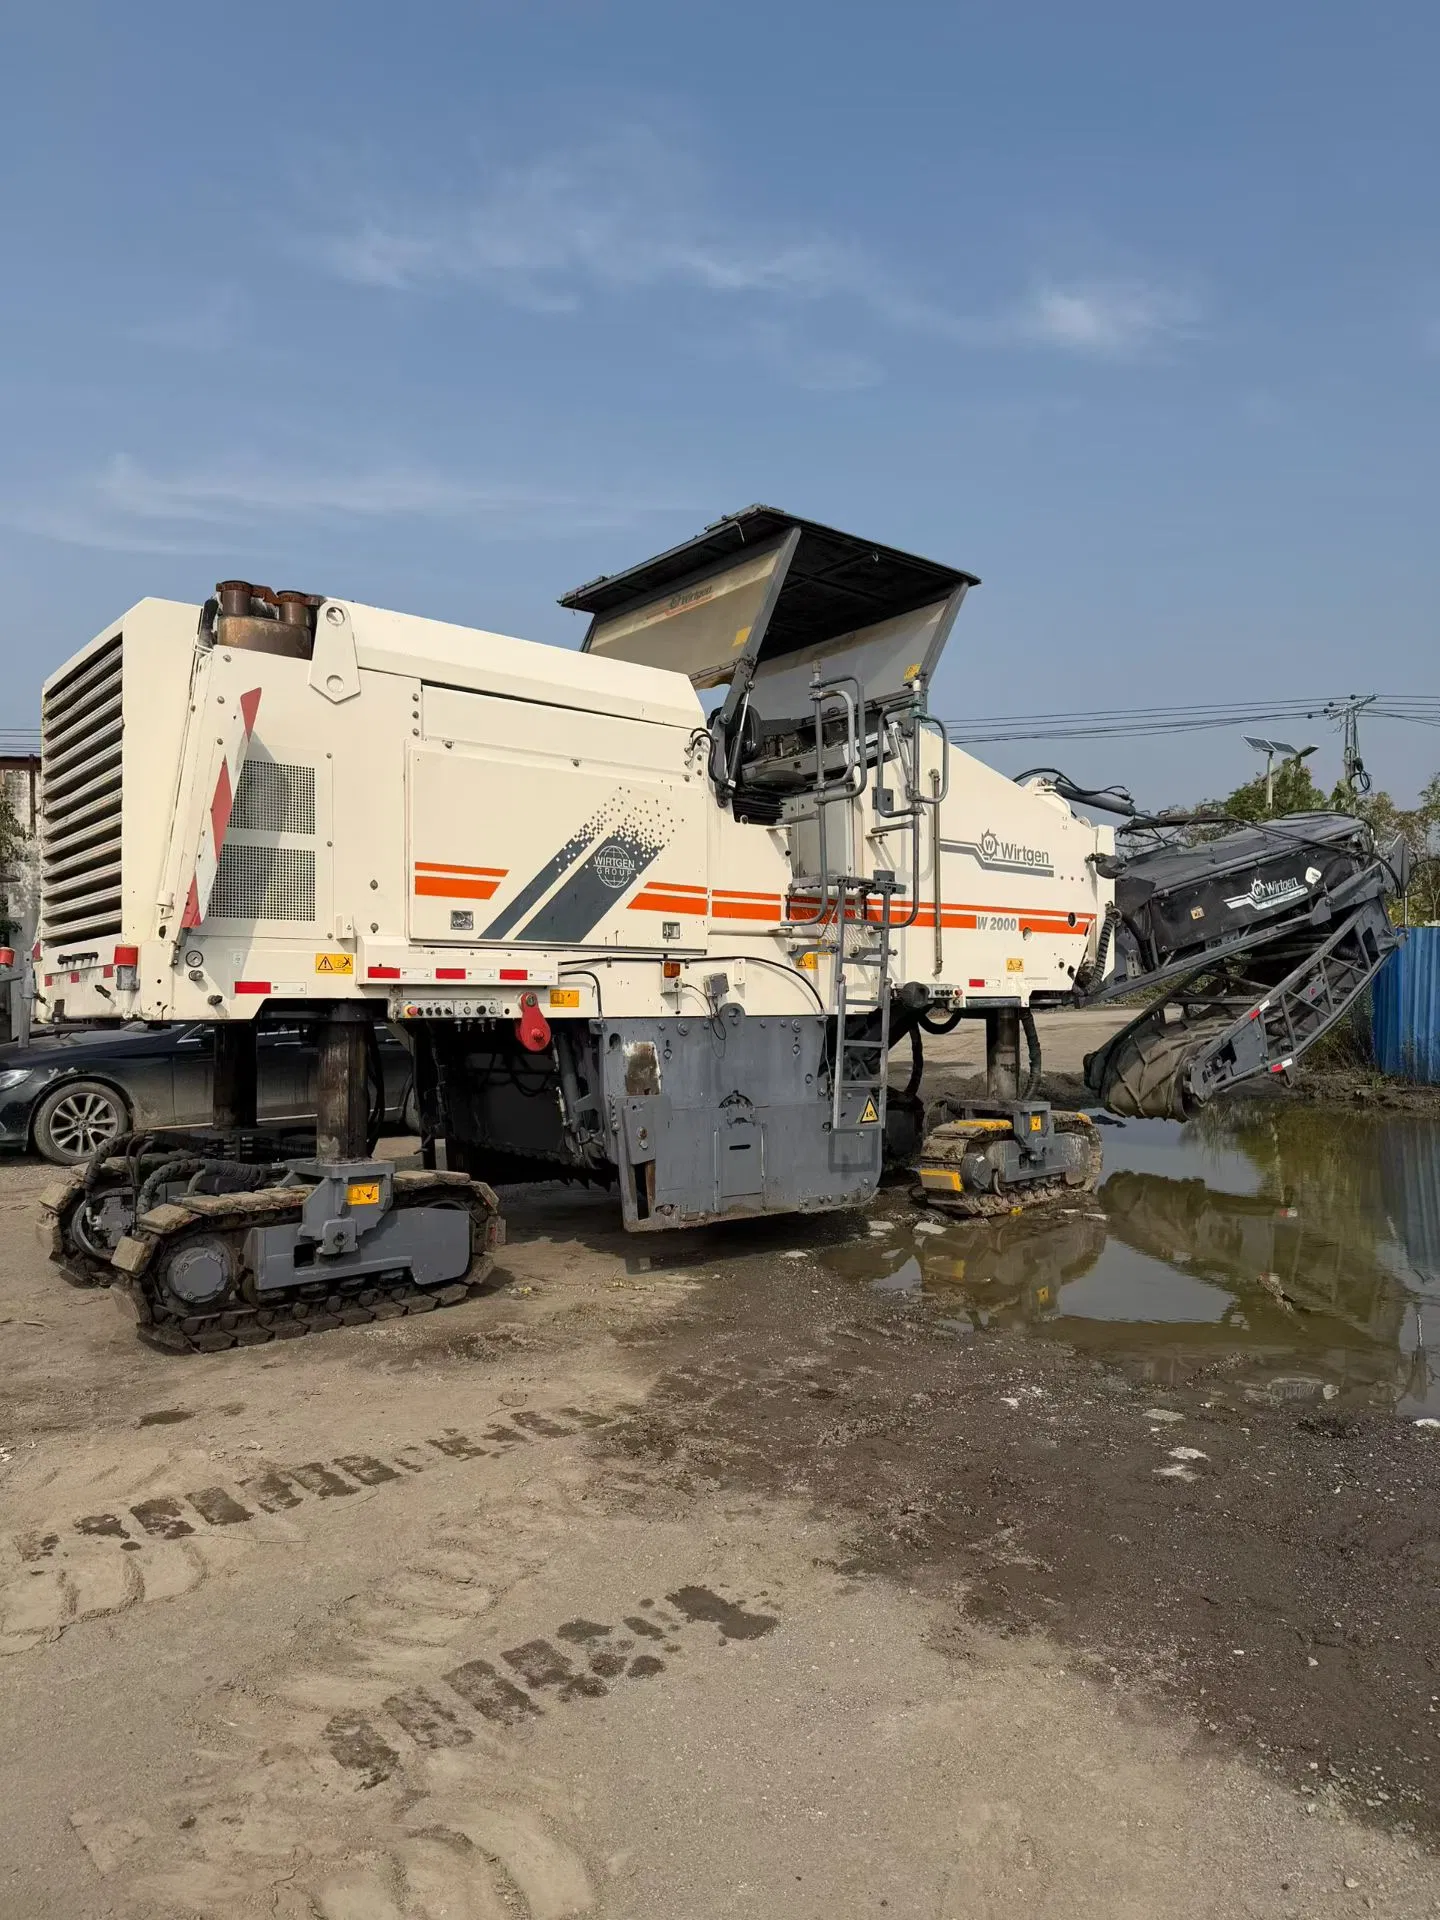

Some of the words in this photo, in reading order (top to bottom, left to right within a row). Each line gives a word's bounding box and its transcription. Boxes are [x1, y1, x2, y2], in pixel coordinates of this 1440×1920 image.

[1000, 841, 1049, 866] Wirtgen
[594, 856, 635, 868] WIRTGEN
[596, 867, 632, 877] GROUP
[1265, 877, 1299, 895] Wirtgen
[977, 915, 988, 930] W
[990, 917, 1017, 931] 2000
